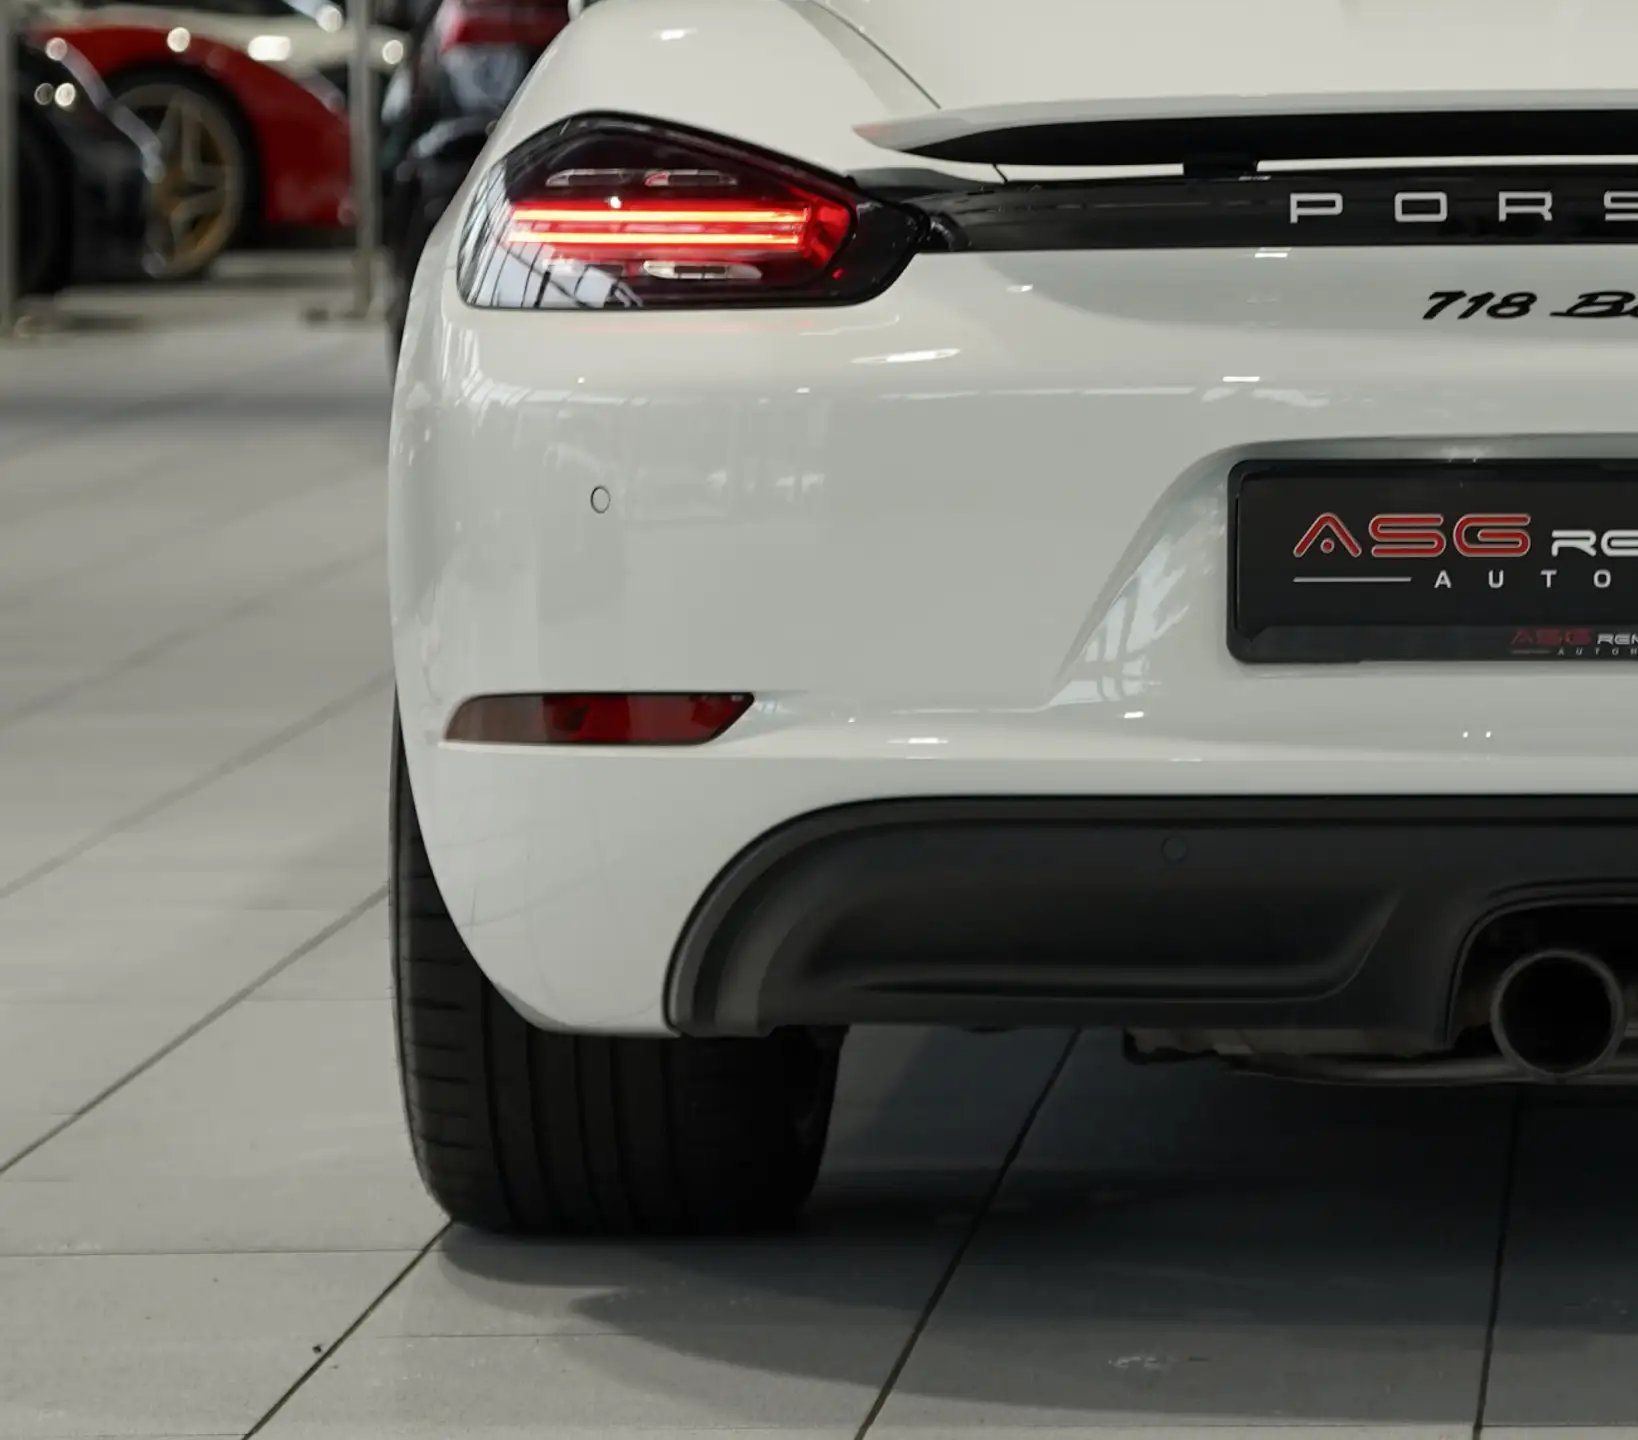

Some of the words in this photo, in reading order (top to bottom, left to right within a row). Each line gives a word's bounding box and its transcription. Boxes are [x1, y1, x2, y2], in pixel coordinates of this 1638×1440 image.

[1422, 291, 1538, 320] 718
[1292, 512, 1532, 558] ASG
[1511, 628, 1592, 645] ASG
